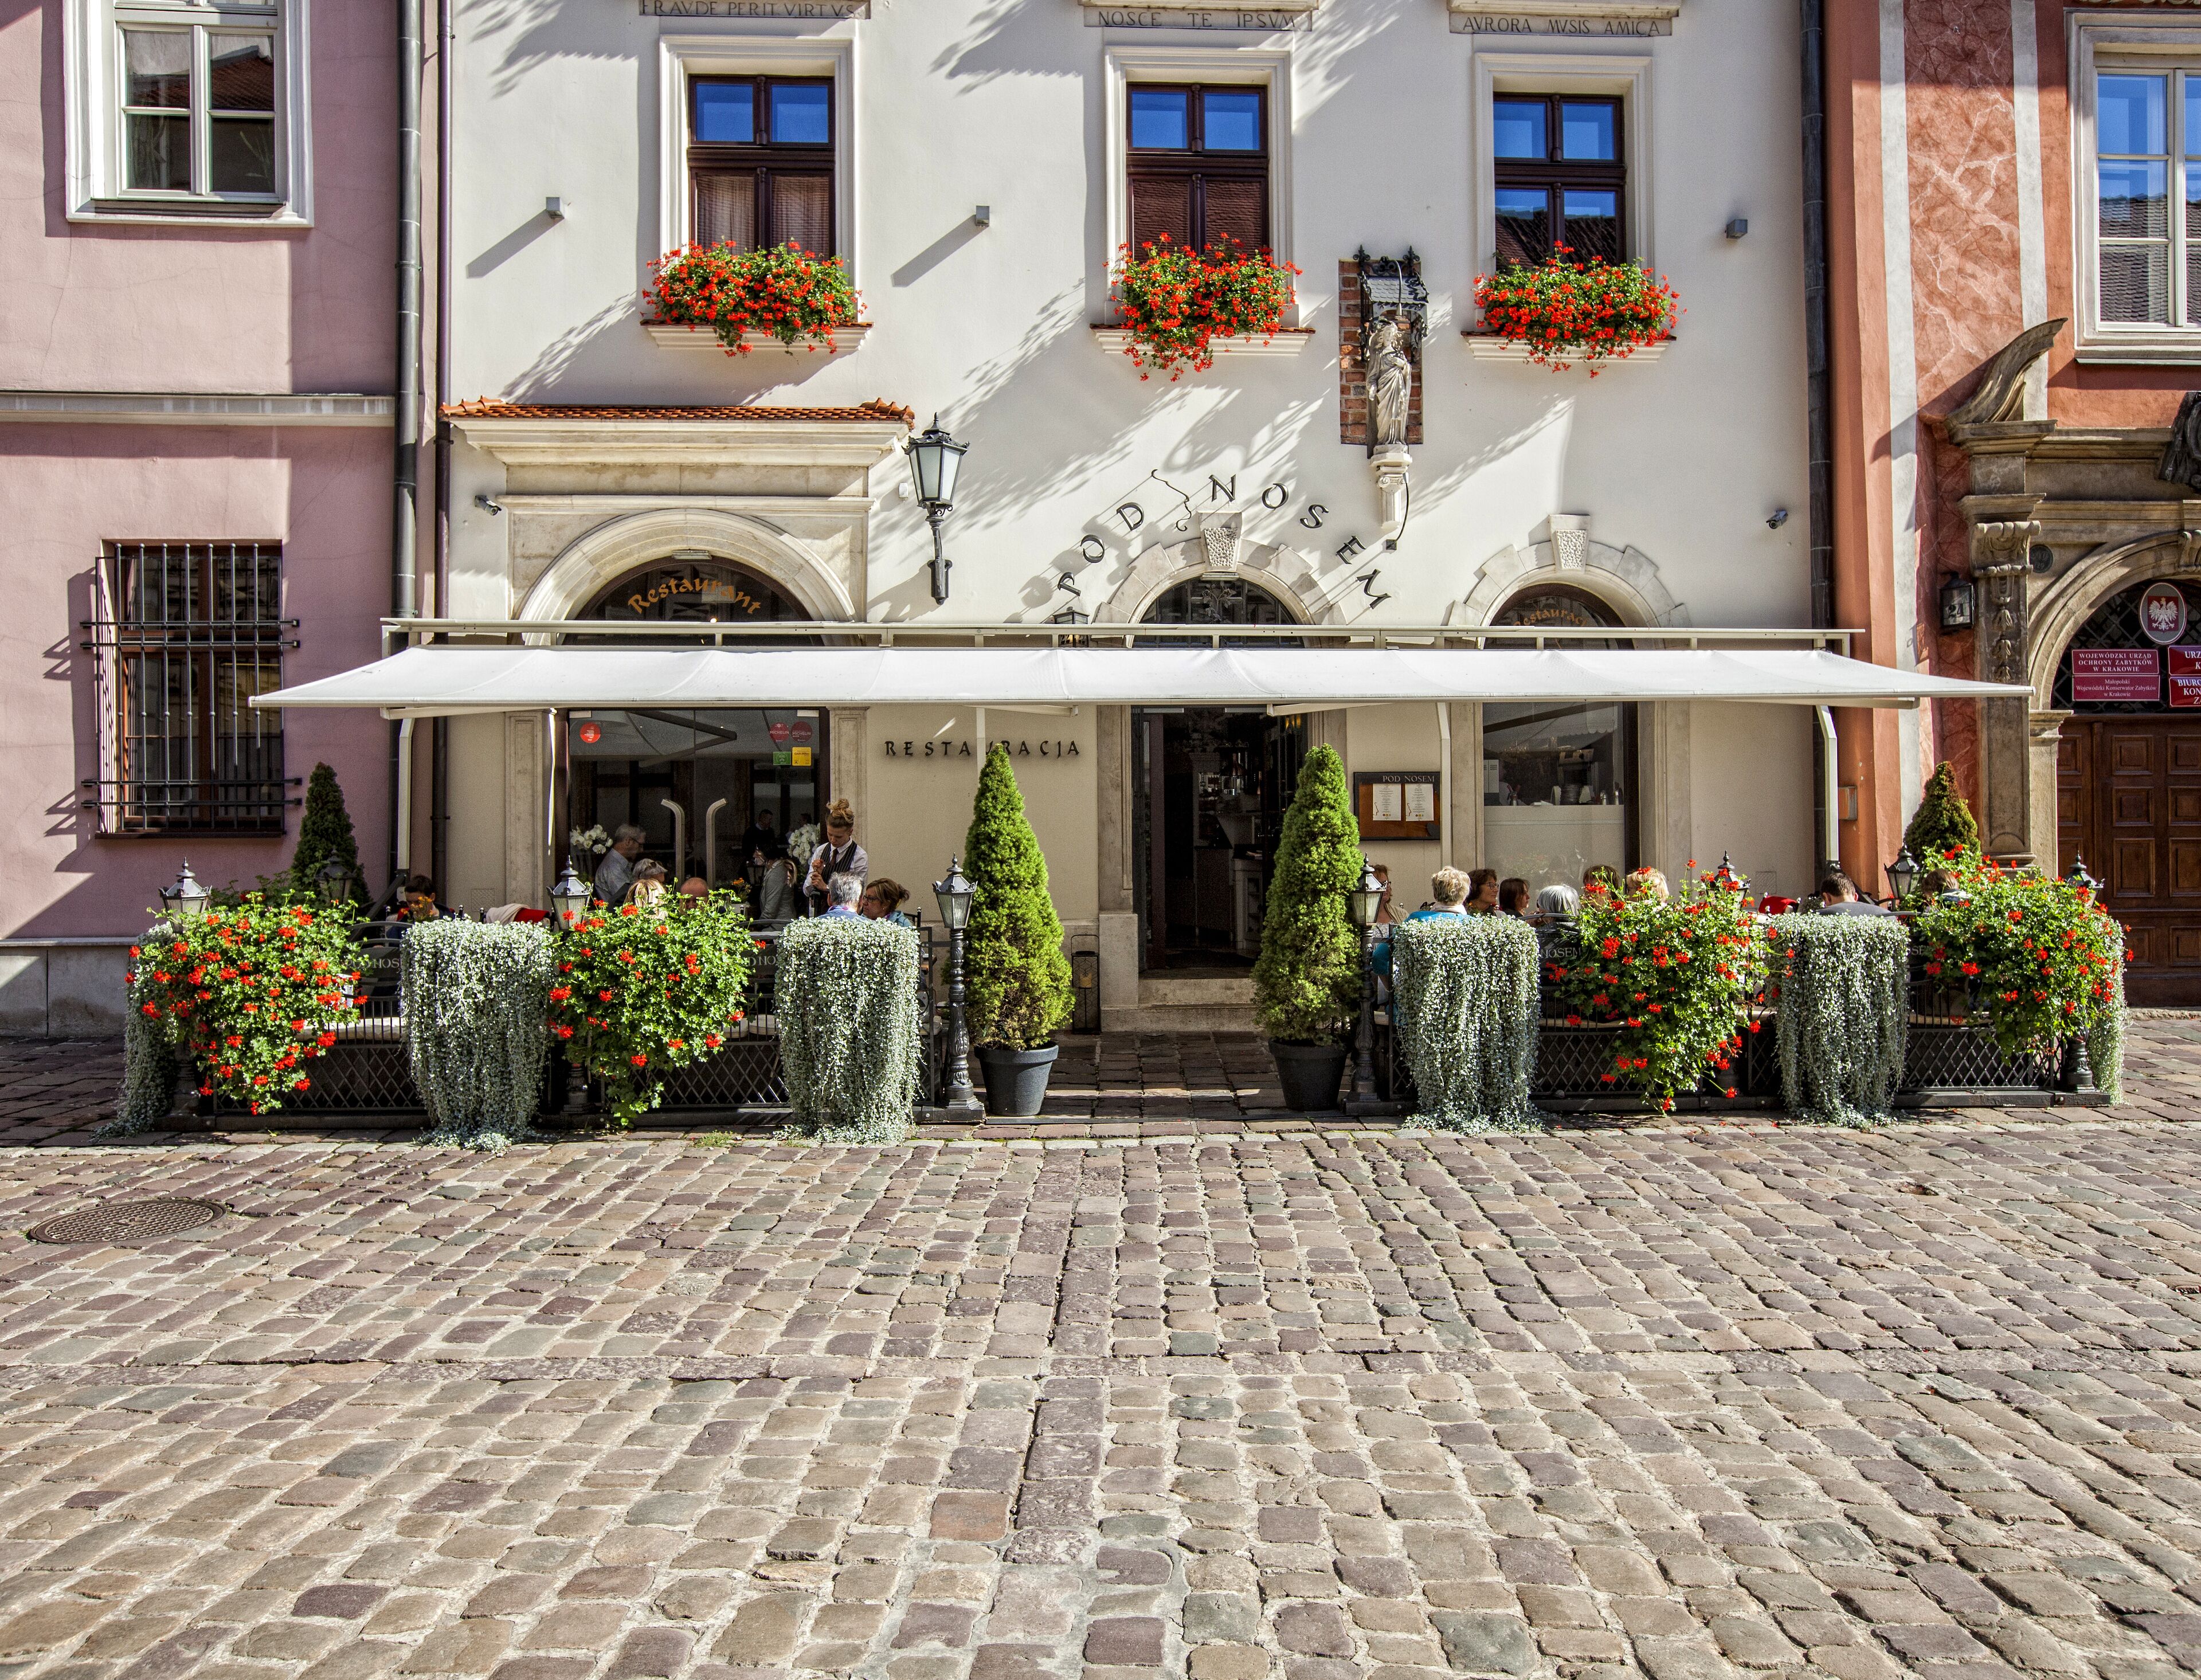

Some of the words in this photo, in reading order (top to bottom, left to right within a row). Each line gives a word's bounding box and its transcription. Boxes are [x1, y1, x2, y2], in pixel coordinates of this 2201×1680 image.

[729, 1, 777, 16] PERIT
[1098, 11, 1162, 27] NOSCE
[1188, 13, 1212, 28] TE
[1236, 14, 1295, 28] IPSVM
[1463, 17, 1532, 33] AVRORA
[1547, 19, 1591, 34] MVSIS
[1604, 20, 1660, 35] AMICA
[1056, 502, 1144, 597] POD
[1209, 473, 1392, 610] NOSEM
[628, 578, 761, 614] Restaurant
[372, 958, 402, 968] NOS
